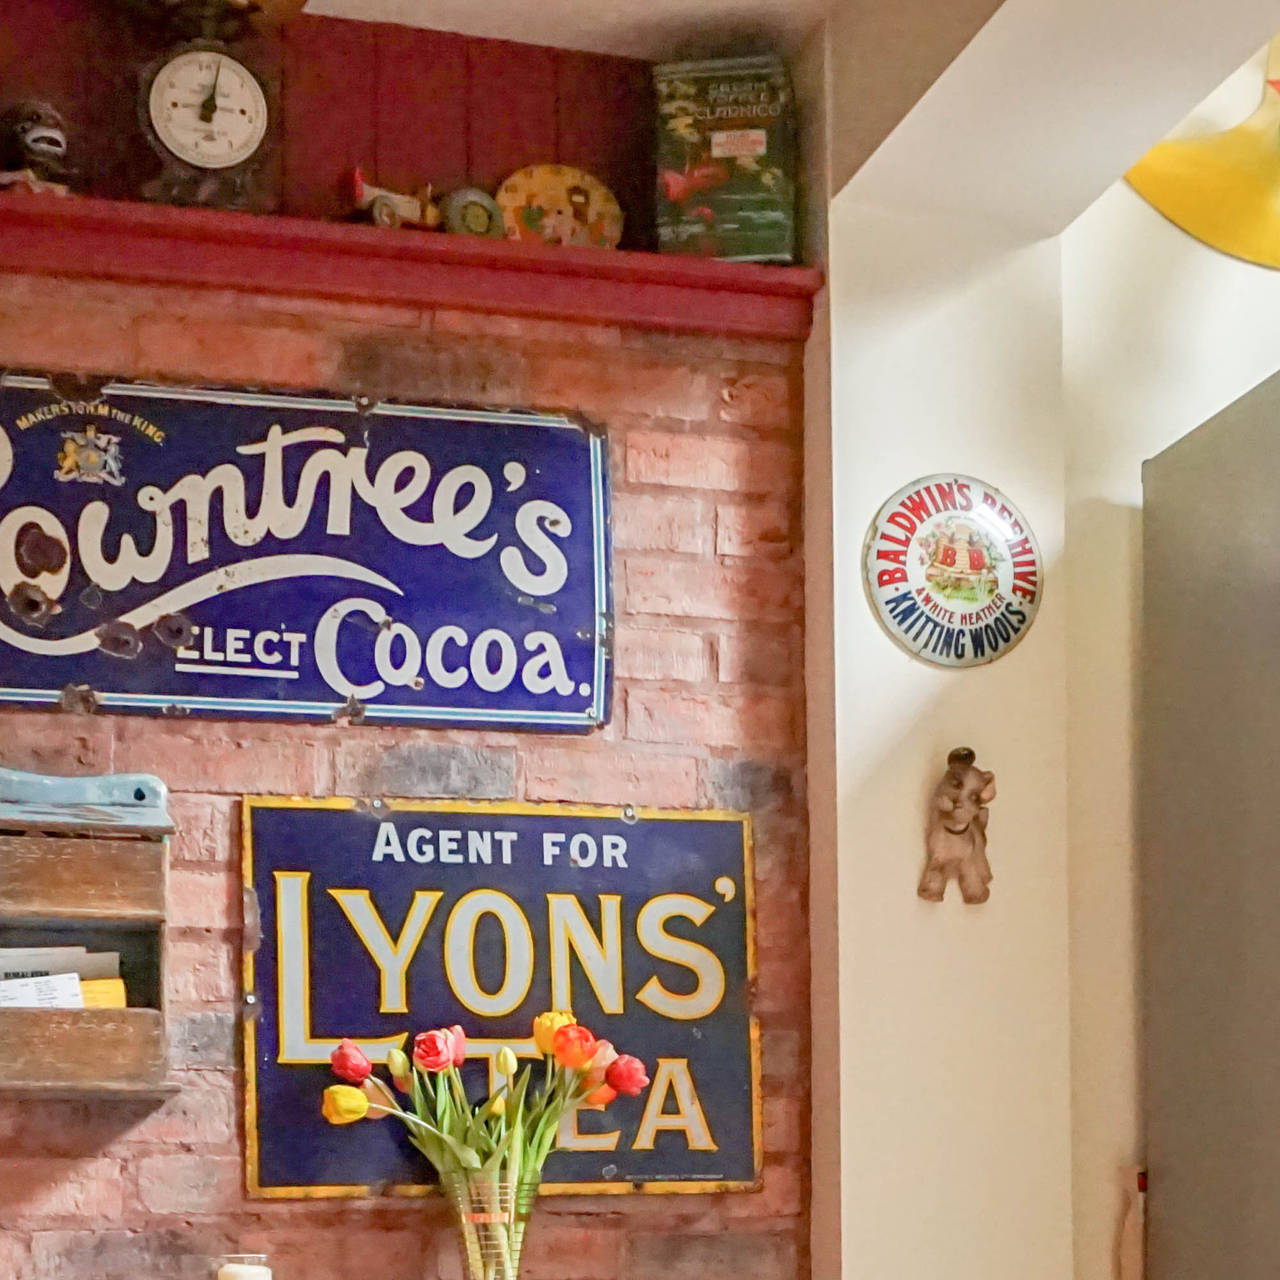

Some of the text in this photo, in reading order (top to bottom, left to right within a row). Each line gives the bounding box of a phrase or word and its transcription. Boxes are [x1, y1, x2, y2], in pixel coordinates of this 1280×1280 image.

[16, 403, 69, 431] MAKERS
[111, 408, 132, 425] THE
[876, 478, 974, 589] BALDWIN'S
[884, 589, 1027, 660] KNITTING WOOLS
[921, 592, 955, 624] WHITE
[960, 592, 1007, 626] HEATHER
[371, 822, 629, 868] AGENT FOR
[272, 870, 737, 1065] LYONS'
